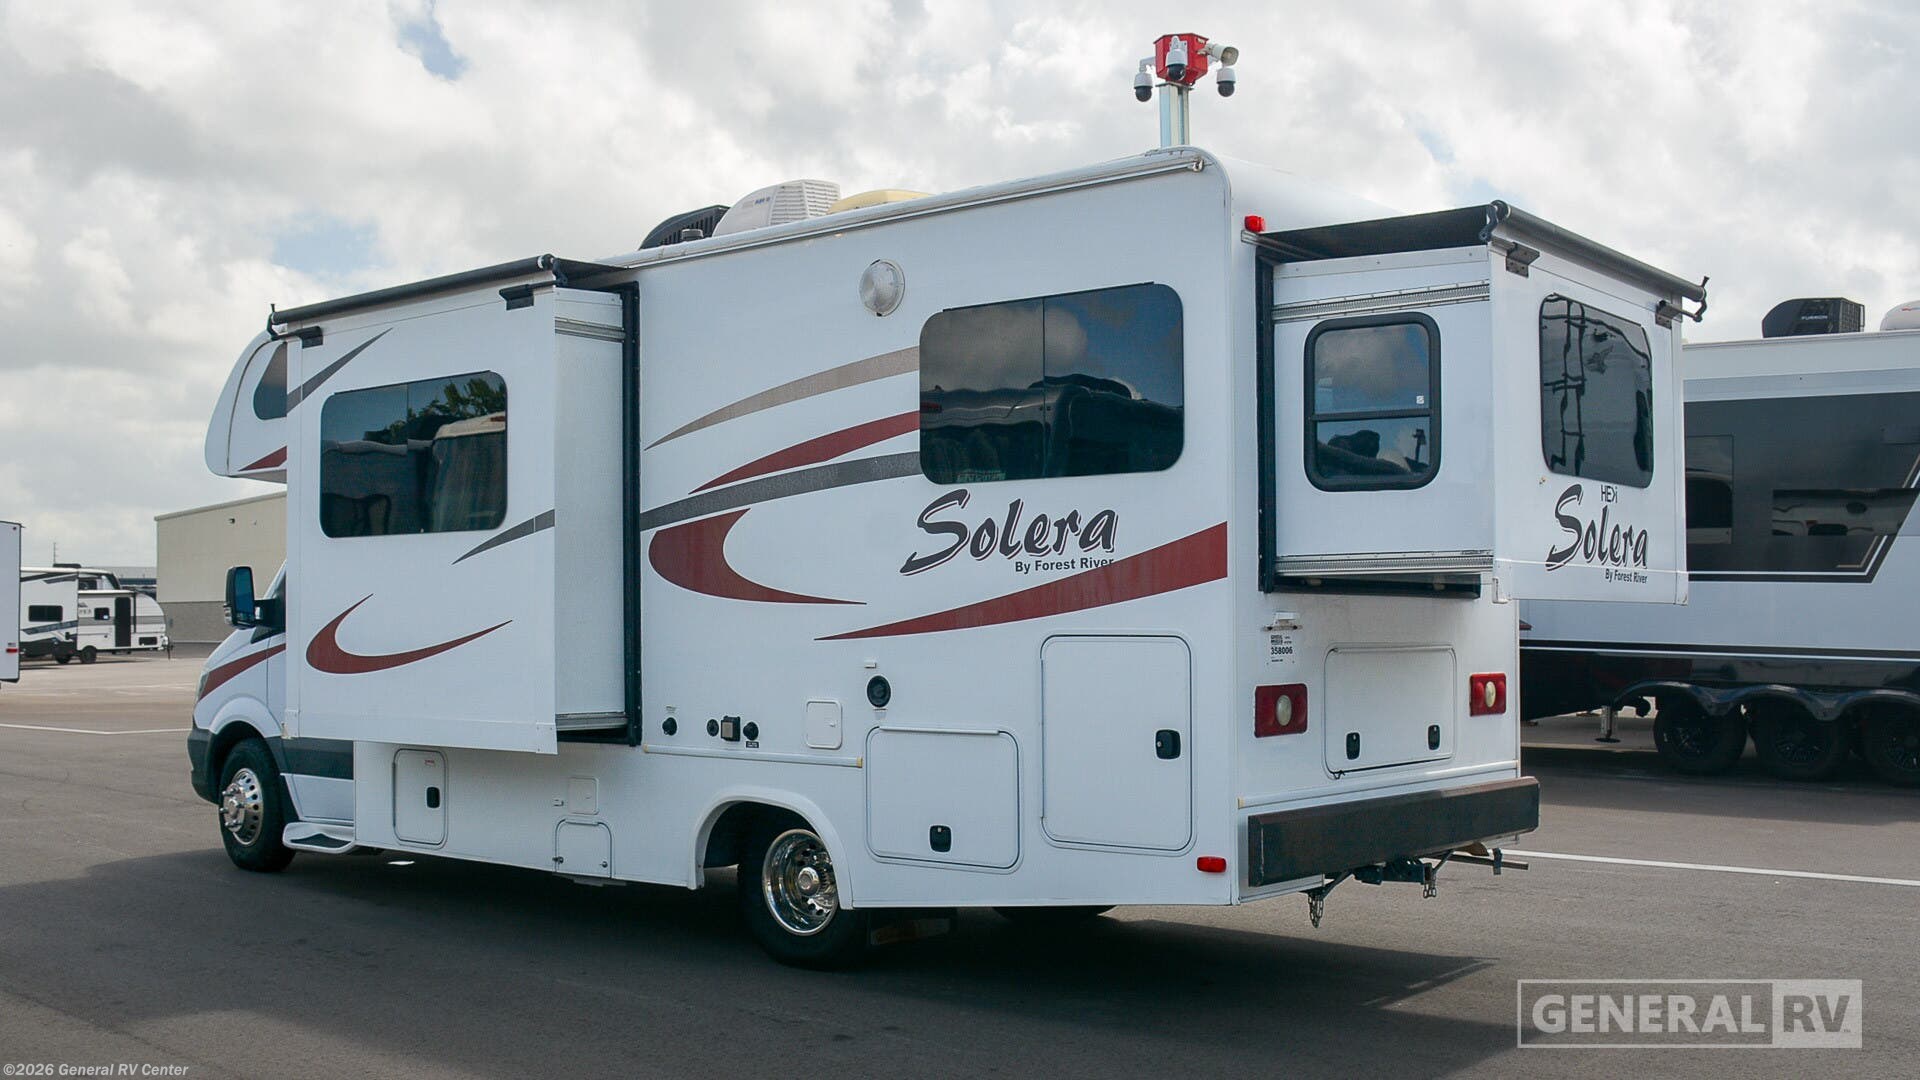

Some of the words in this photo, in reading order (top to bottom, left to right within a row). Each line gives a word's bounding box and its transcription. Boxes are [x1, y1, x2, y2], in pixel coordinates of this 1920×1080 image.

[900, 488, 1118, 576] Solera
[1545, 484, 1648, 571] Solera
[1015, 561, 1031, 575] By
[1035, 558, 1076, 571] Forest
[1080, 557, 1114, 569] River
[1605, 568, 1613, 583] By
[1614, 569, 1632, 582] Forest
[1633, 572, 1648, 584] River
[1271, 646, 1293, 655] 358006
